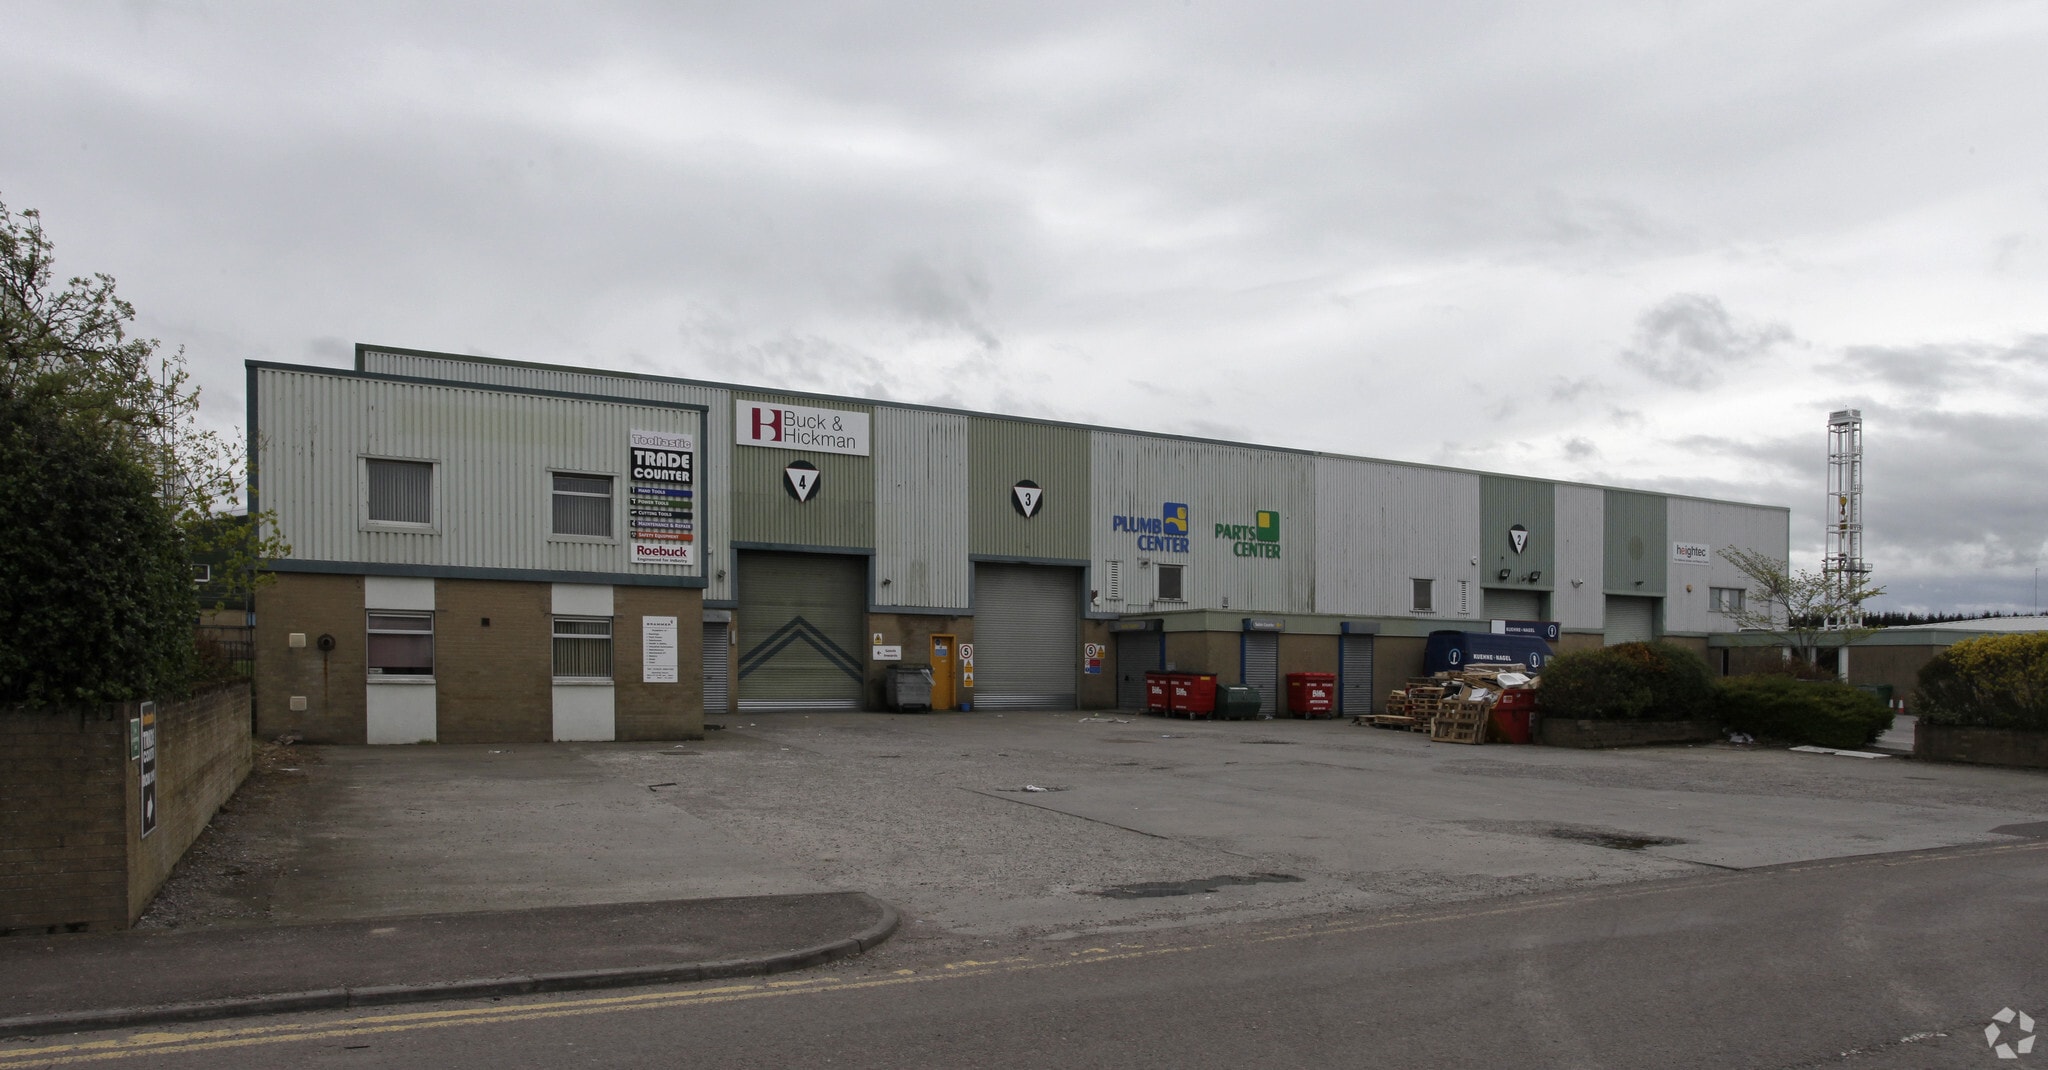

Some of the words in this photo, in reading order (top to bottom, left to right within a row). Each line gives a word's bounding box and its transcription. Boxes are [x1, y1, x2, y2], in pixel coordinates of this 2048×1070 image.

[784, 410, 826, 430] Buck
[832, 415, 843, 432] &
[632, 434, 691, 449] Tooltastic
[784, 427, 856, 449] Hickman
[634, 450, 690, 469] TRADE
[634, 467, 690, 482] COUNTER
[799, 475, 806, 490] 4
[1025, 492, 1031, 506] 3
[1113, 515, 1162, 535] PLUMB
[1215, 523, 1257, 541] PARTS
[1137, 534, 1189, 554] CENTER
[1516, 534, 1522, 546] 2
[637, 545, 687, 557] Roebuck
[1233, 541, 1281, 559] CENTER
[1676, 544, 1706, 558] heightec
[964, 647, 969, 656] 5
[1088, 646, 1093, 655] 5
